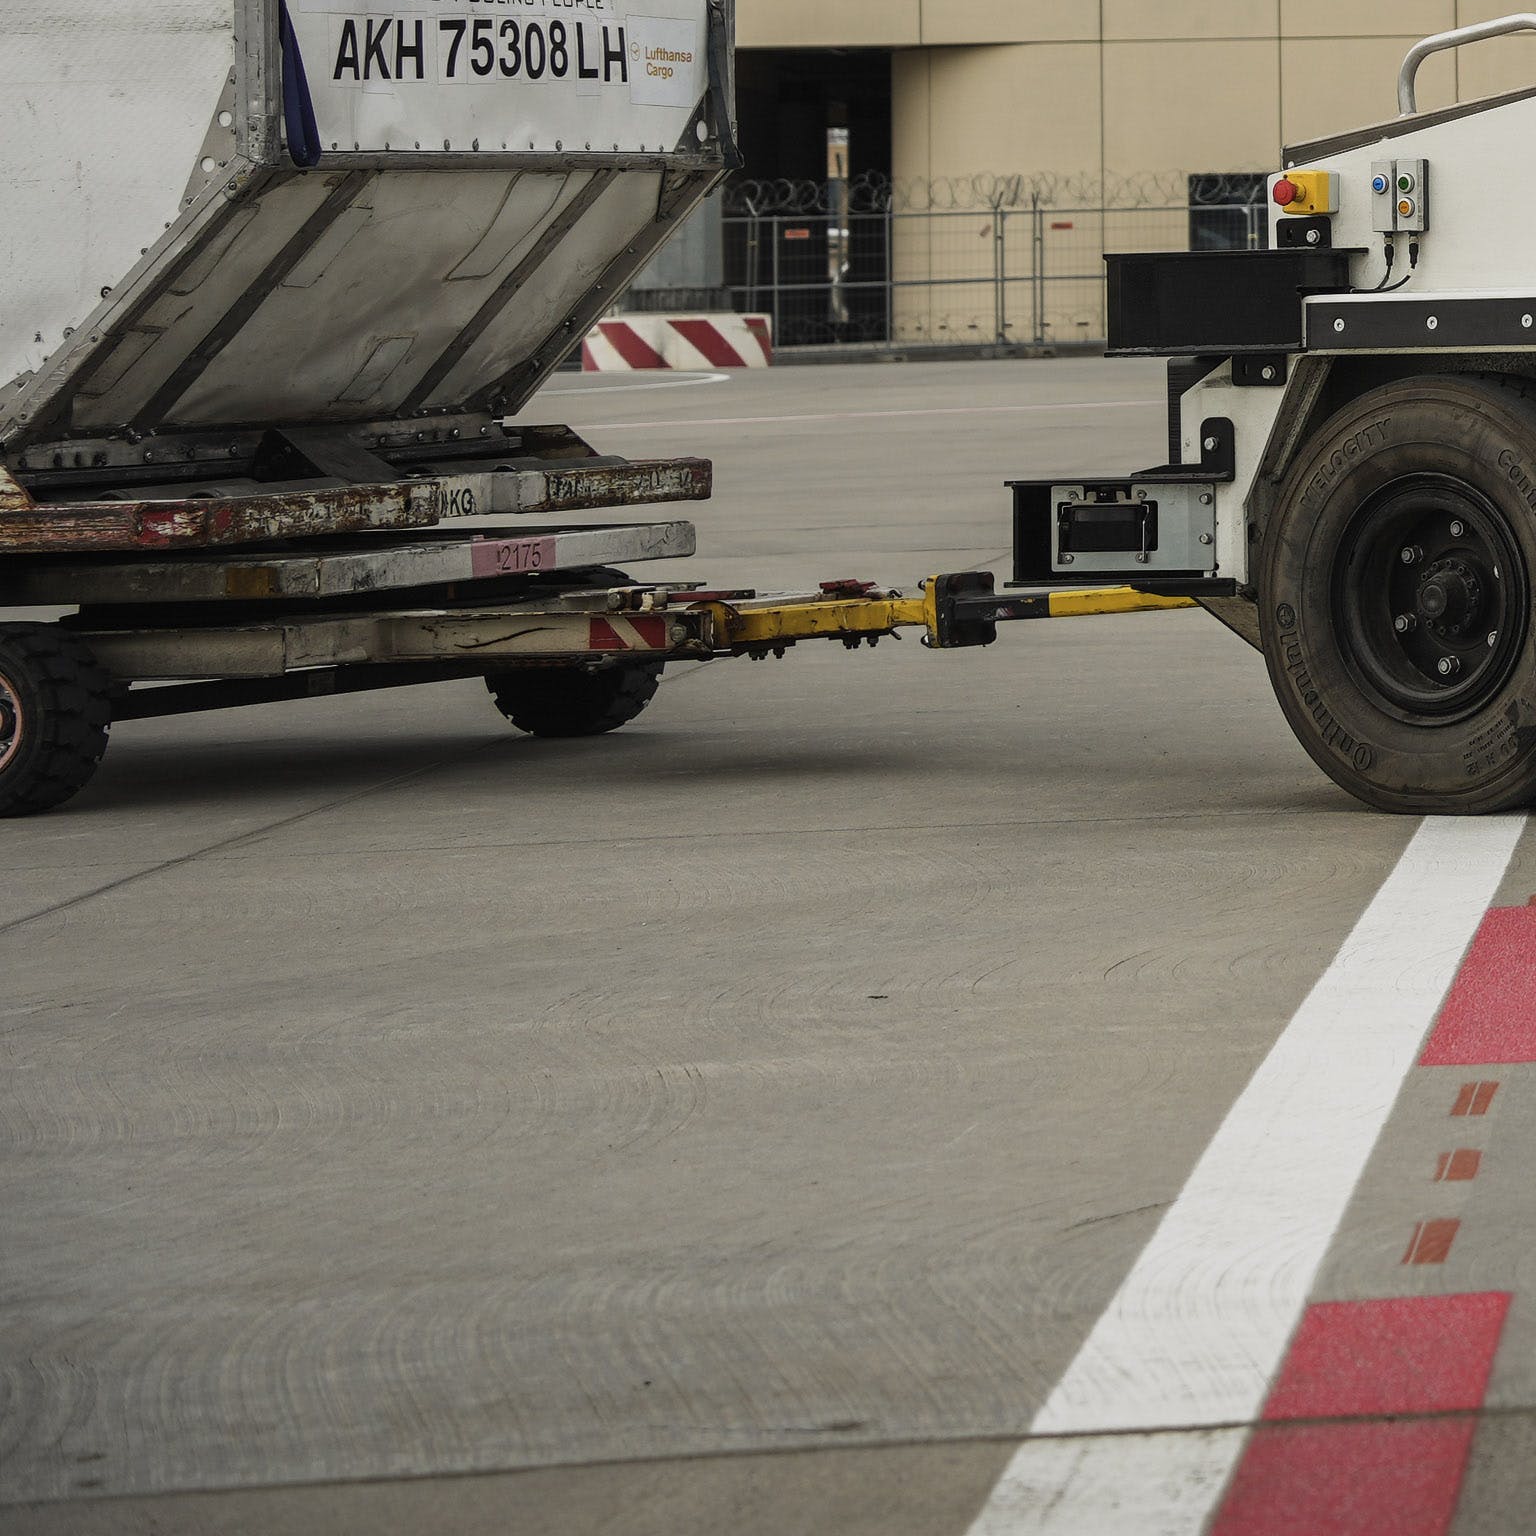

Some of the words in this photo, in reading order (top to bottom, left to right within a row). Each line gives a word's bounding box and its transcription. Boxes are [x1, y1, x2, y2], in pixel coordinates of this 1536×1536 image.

[332, 19, 424, 81] AKH
[645, 46, 693, 63] Lufthansa
[646, 62, 674, 80] Cargo
